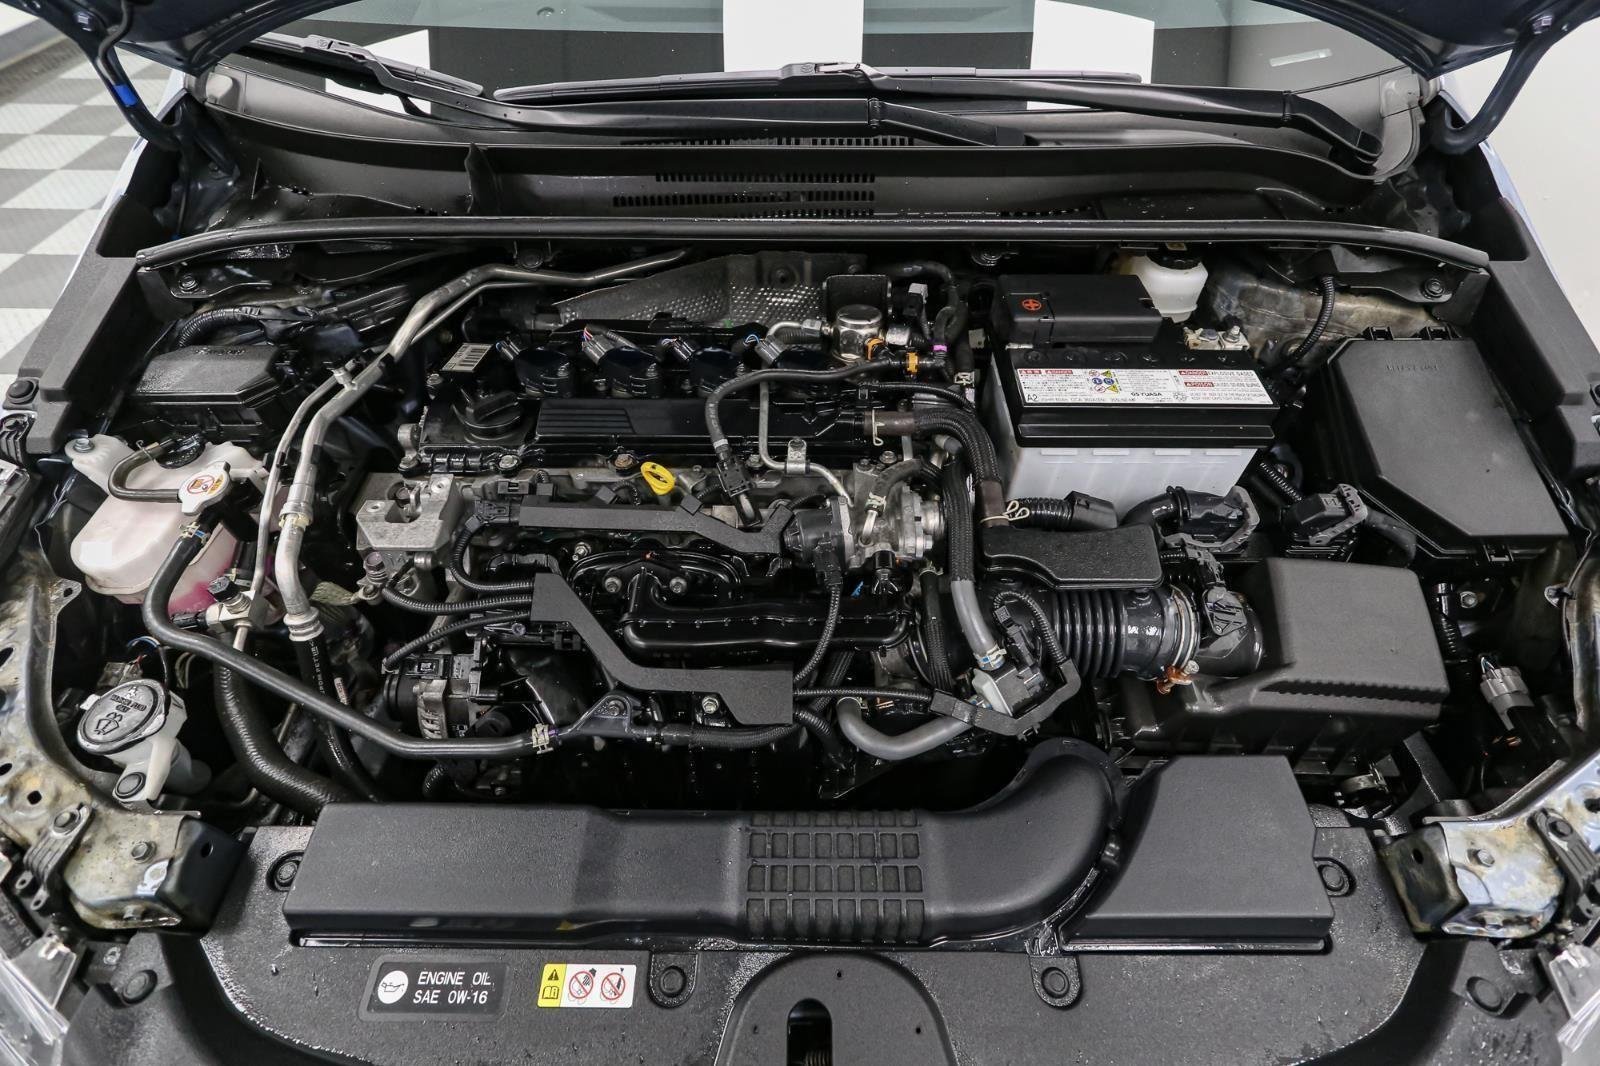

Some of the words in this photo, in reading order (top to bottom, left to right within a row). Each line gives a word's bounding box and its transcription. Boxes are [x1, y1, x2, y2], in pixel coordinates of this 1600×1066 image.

[417, 971, 465, 985] ENGINE
[472, 972, 492, 985] OIL
[413, 990, 441, 1004] SAE
[447, 990, 488, 1004] 0W-16
